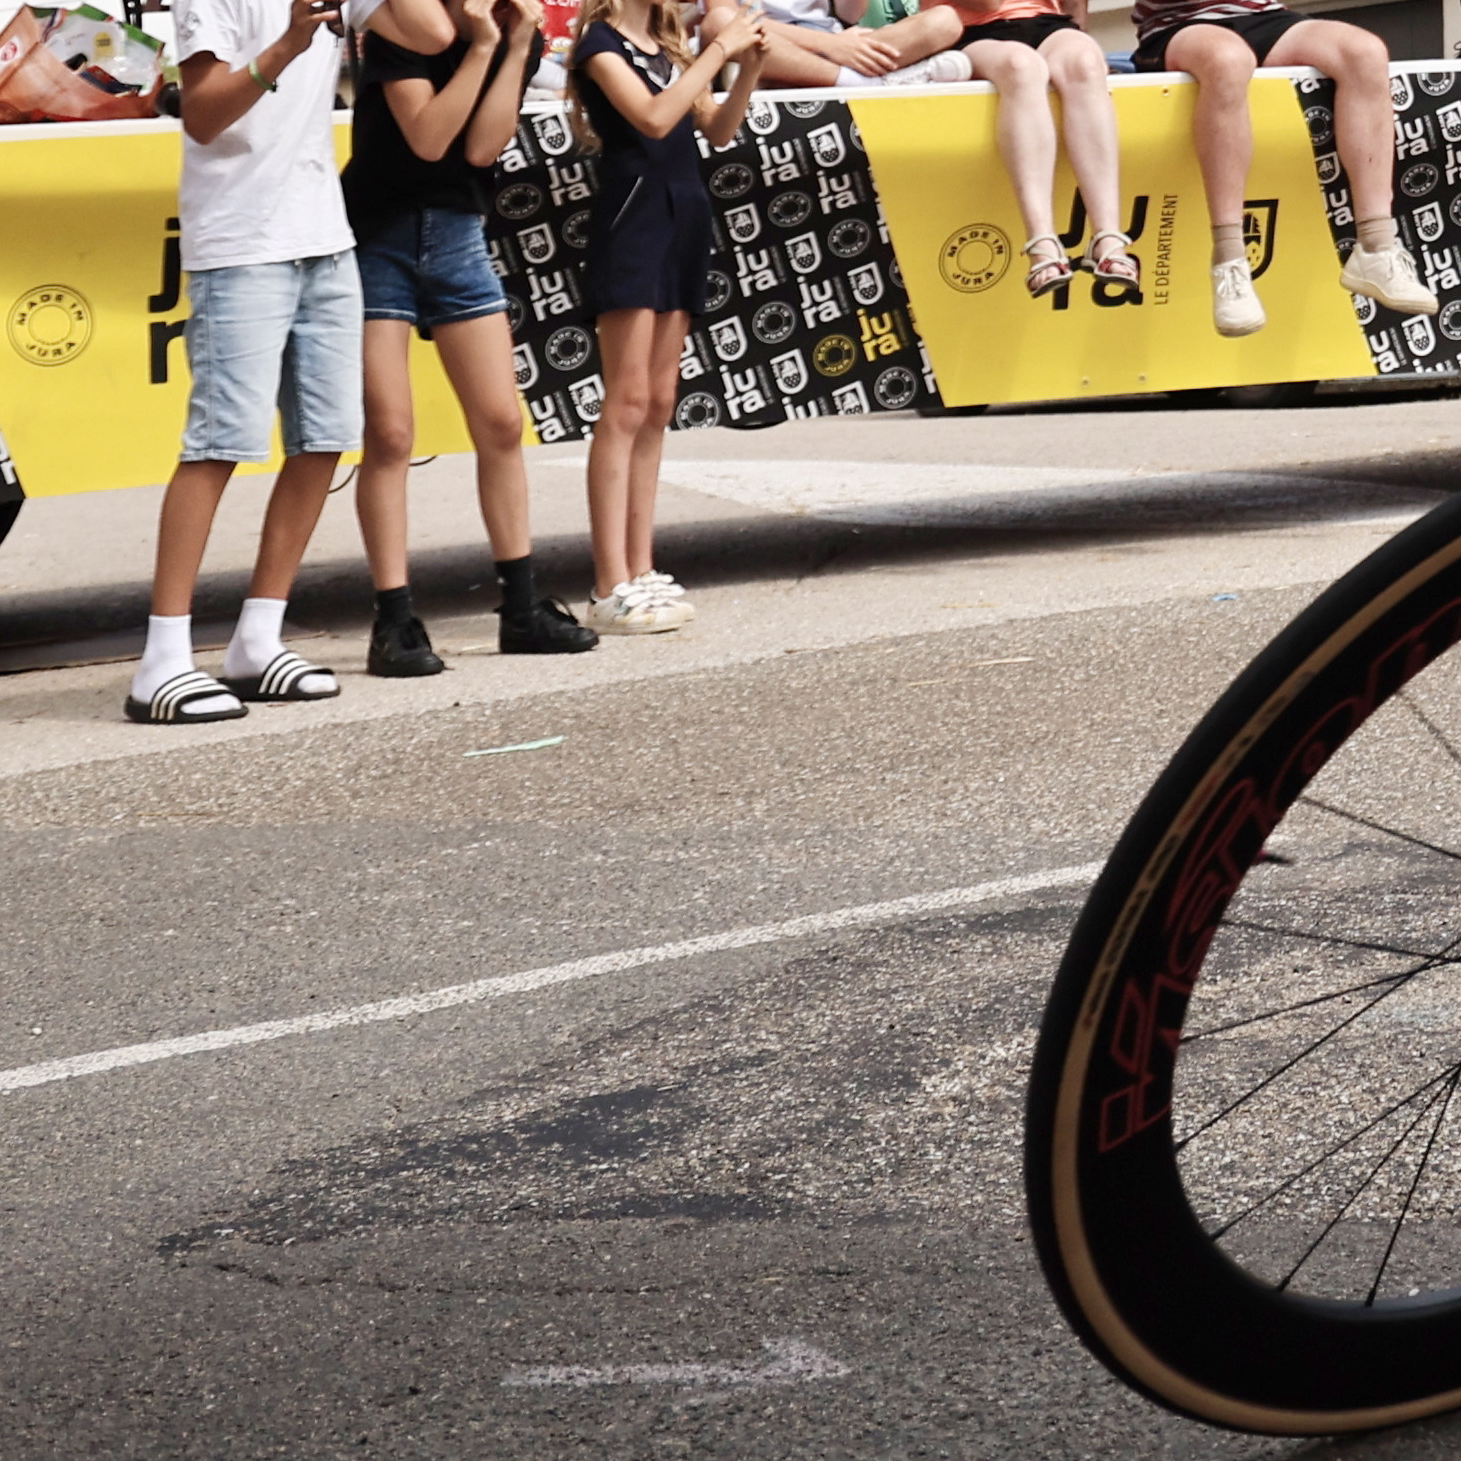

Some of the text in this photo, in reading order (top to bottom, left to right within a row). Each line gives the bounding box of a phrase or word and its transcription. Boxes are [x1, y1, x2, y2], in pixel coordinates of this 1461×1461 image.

[755, 136, 793, 169] ju
[546, 158, 583, 189] ju
[761, 162, 801, 187] ra
[816, 170, 851, 197] ju
[550, 183, 591, 206] ra
[819, 188, 857, 214] ra
[947, 230, 1006, 258] MADE IN
[1154, 192, 1180, 307] LE DÉPARTEMENT
[1420, 244, 1451, 276] ju
[148, 217, 181, 314] j
[733, 245, 769, 278] ju
[526, 267, 565, 301] ju
[738, 269, 779, 297] ra
[796, 276, 832, 308] ju
[951, 270, 996, 290] JURA
[17, 292, 86, 327] MADE IN
[530, 289, 574, 321] ra
[803, 300, 842, 329] ra
[856, 309, 893, 341] ju
[25, 338, 77, 358] JURA
[150, 320, 188, 384] r
[862, 333, 901, 362] ra
[719, 365, 756, 400] ju
[726, 389, 768, 421] ra
